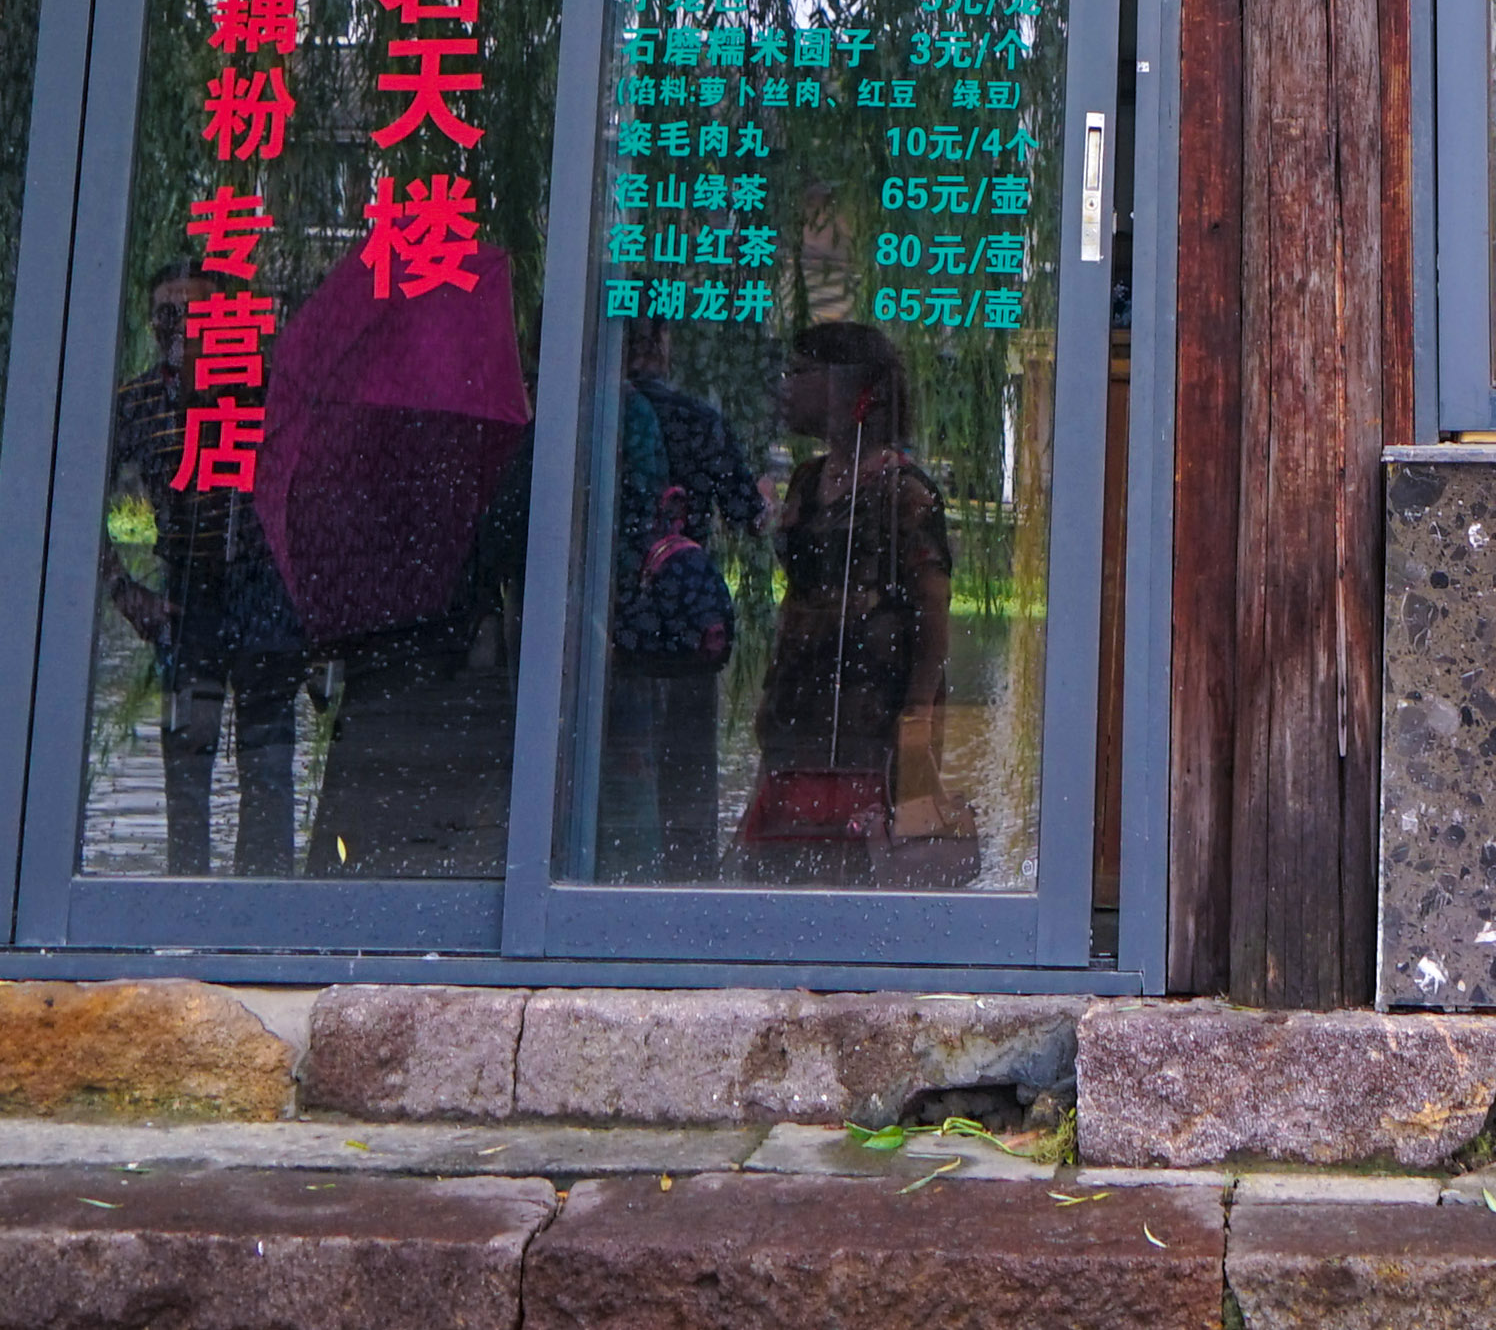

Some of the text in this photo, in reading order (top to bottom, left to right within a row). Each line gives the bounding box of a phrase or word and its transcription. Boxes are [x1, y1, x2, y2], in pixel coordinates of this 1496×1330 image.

[622, 27, 1030, 71] 石磨糯米圆子 3元/个
[887, 127, 1041, 163] 10元/4个
[616, 174, 1030, 216] 径山绿茶 65元/壶
[608, 224, 1025, 276] 径山红茶 80元/壶
[606, 280, 1023, 329] 西湖龙井 65元/壶
